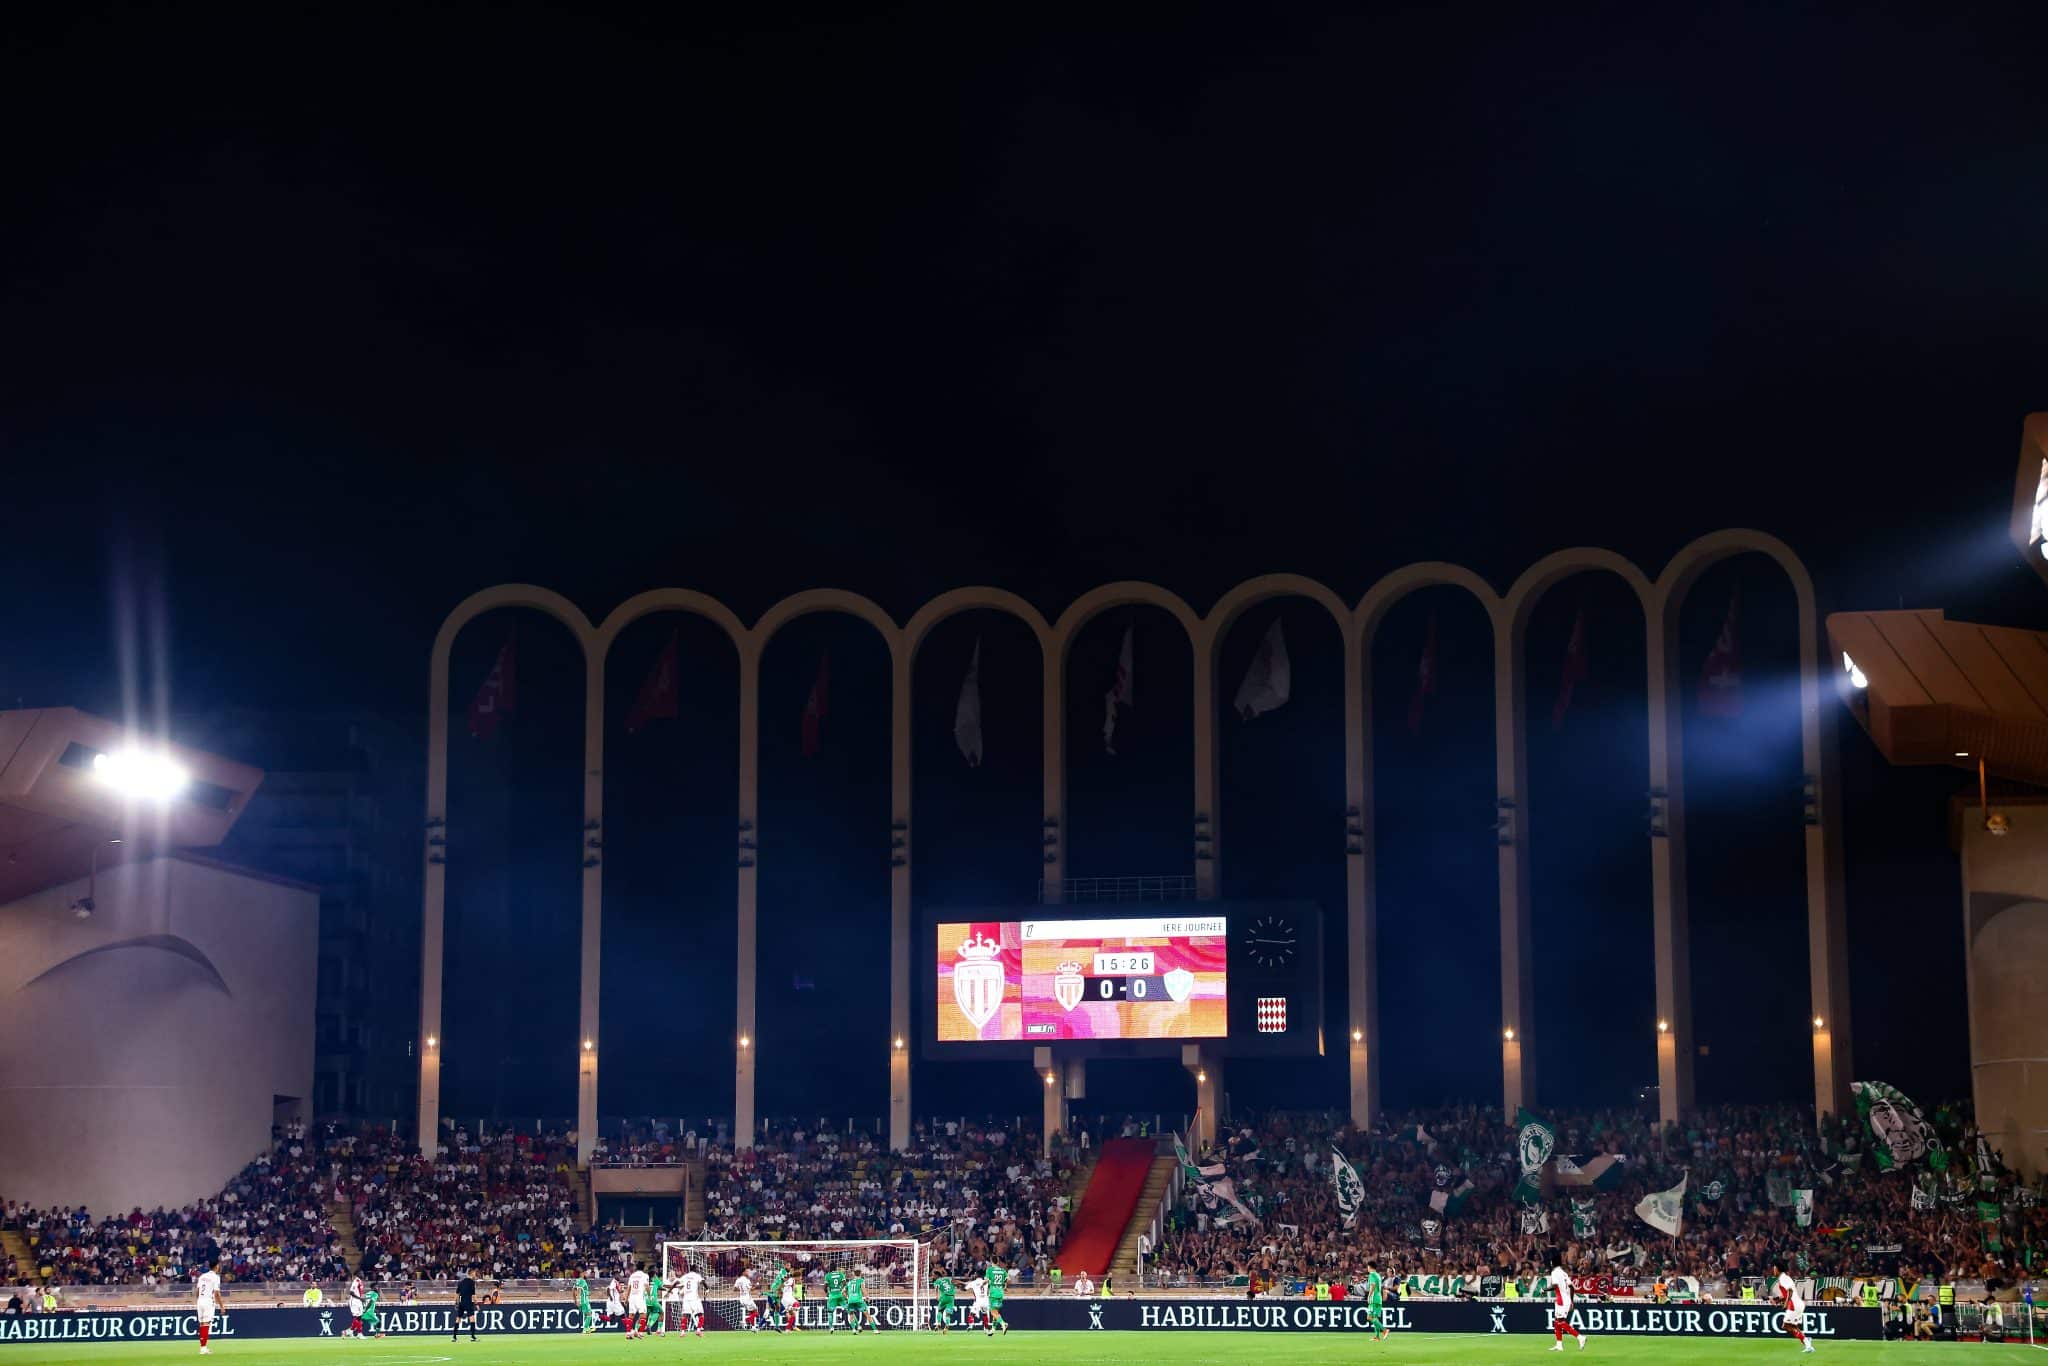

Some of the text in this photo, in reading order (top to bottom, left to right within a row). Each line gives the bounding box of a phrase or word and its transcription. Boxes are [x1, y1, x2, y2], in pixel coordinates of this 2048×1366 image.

[1100, 957, 1149, 971] 15:26
[1100, 979, 1114, 998] 0
[1133, 978, 1147, 998] 0
[128, 1314, 234, 1338] OFFICEL
[509, 1308, 618, 1331] OFFICEL
[1140, 1305, 1412, 1329] HABILLEUR OFFICEL
[1708, 1310, 1835, 1336] OFFICEL
